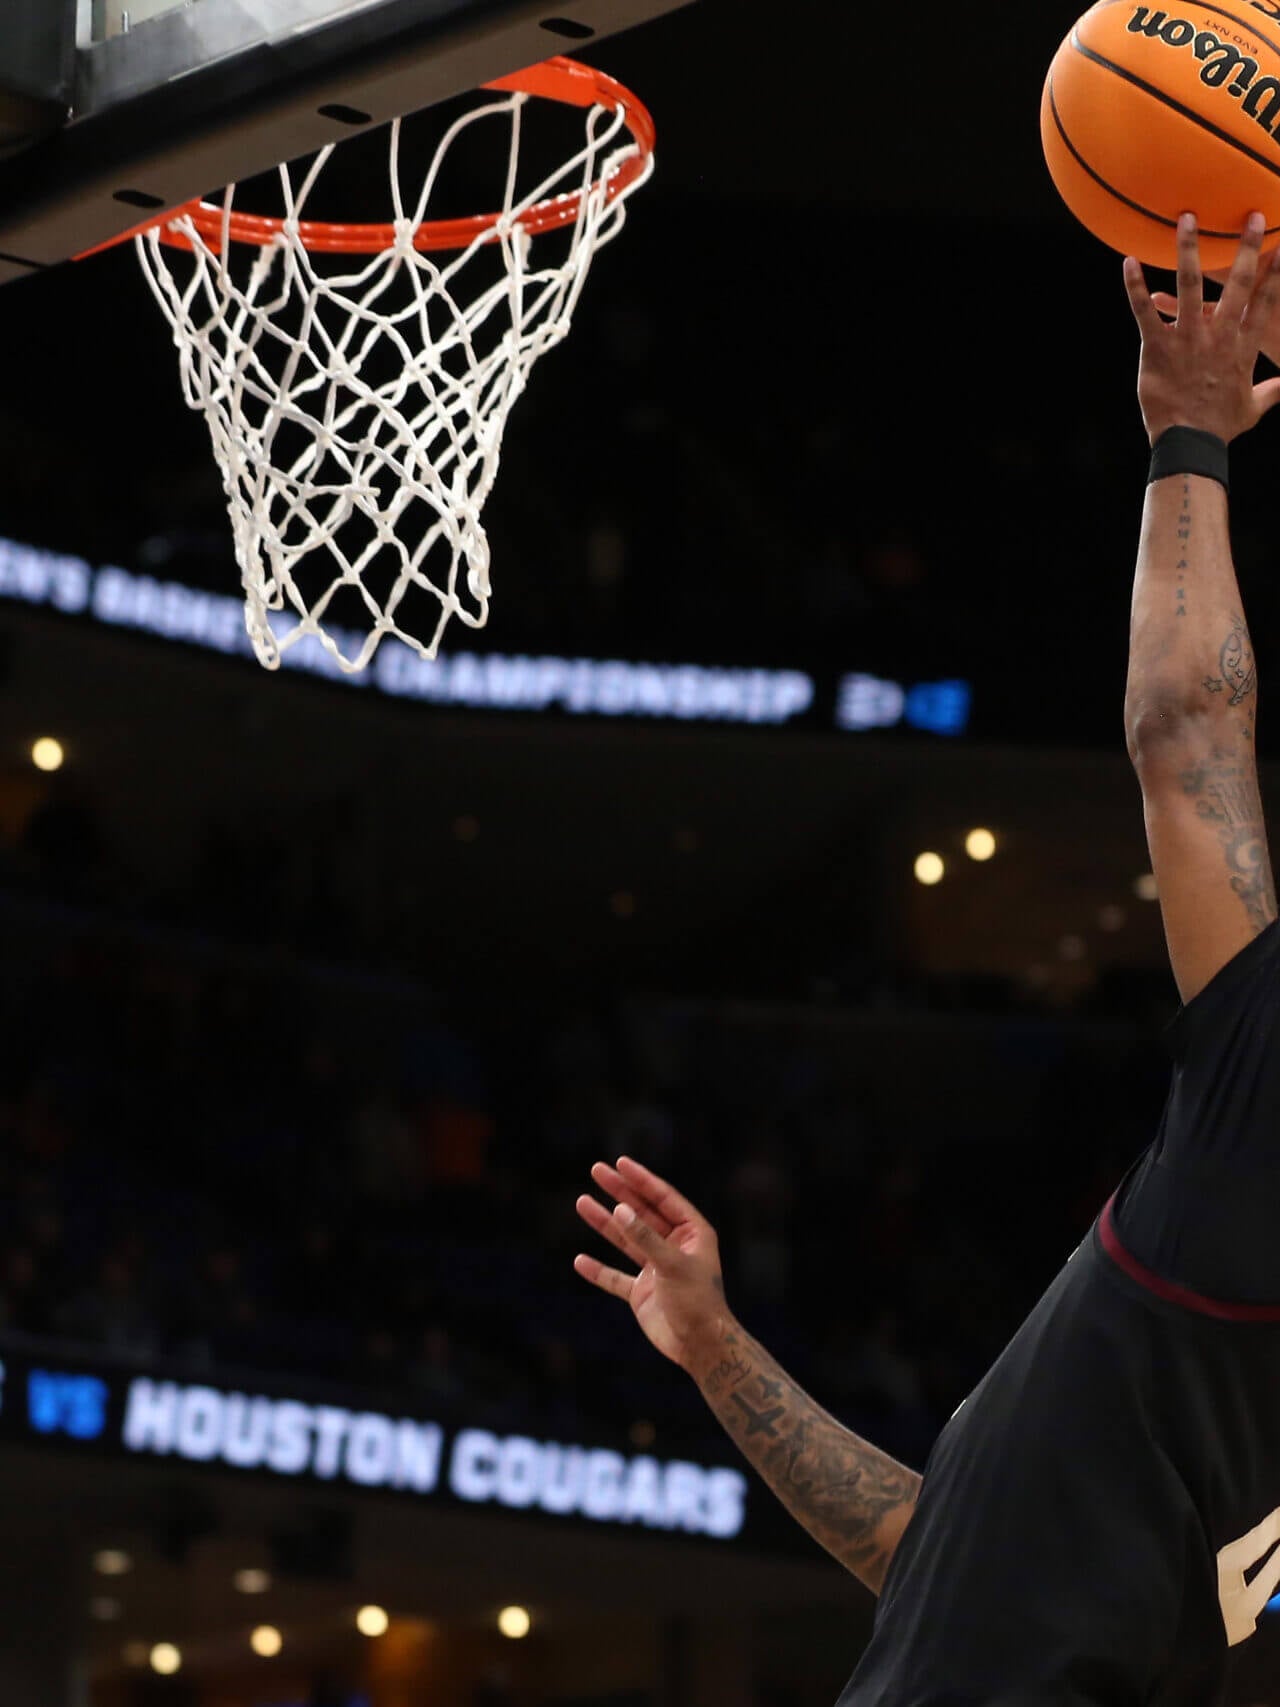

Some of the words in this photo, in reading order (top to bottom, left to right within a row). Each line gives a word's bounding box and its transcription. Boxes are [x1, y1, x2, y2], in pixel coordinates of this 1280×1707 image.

[375, 645, 813, 724] CHAMPIONSHIP
[27, 1367, 108, 1439] VS
[122, 1376, 443, 1493] HOUSTON
[448, 1428, 748, 1539] COUGARS
